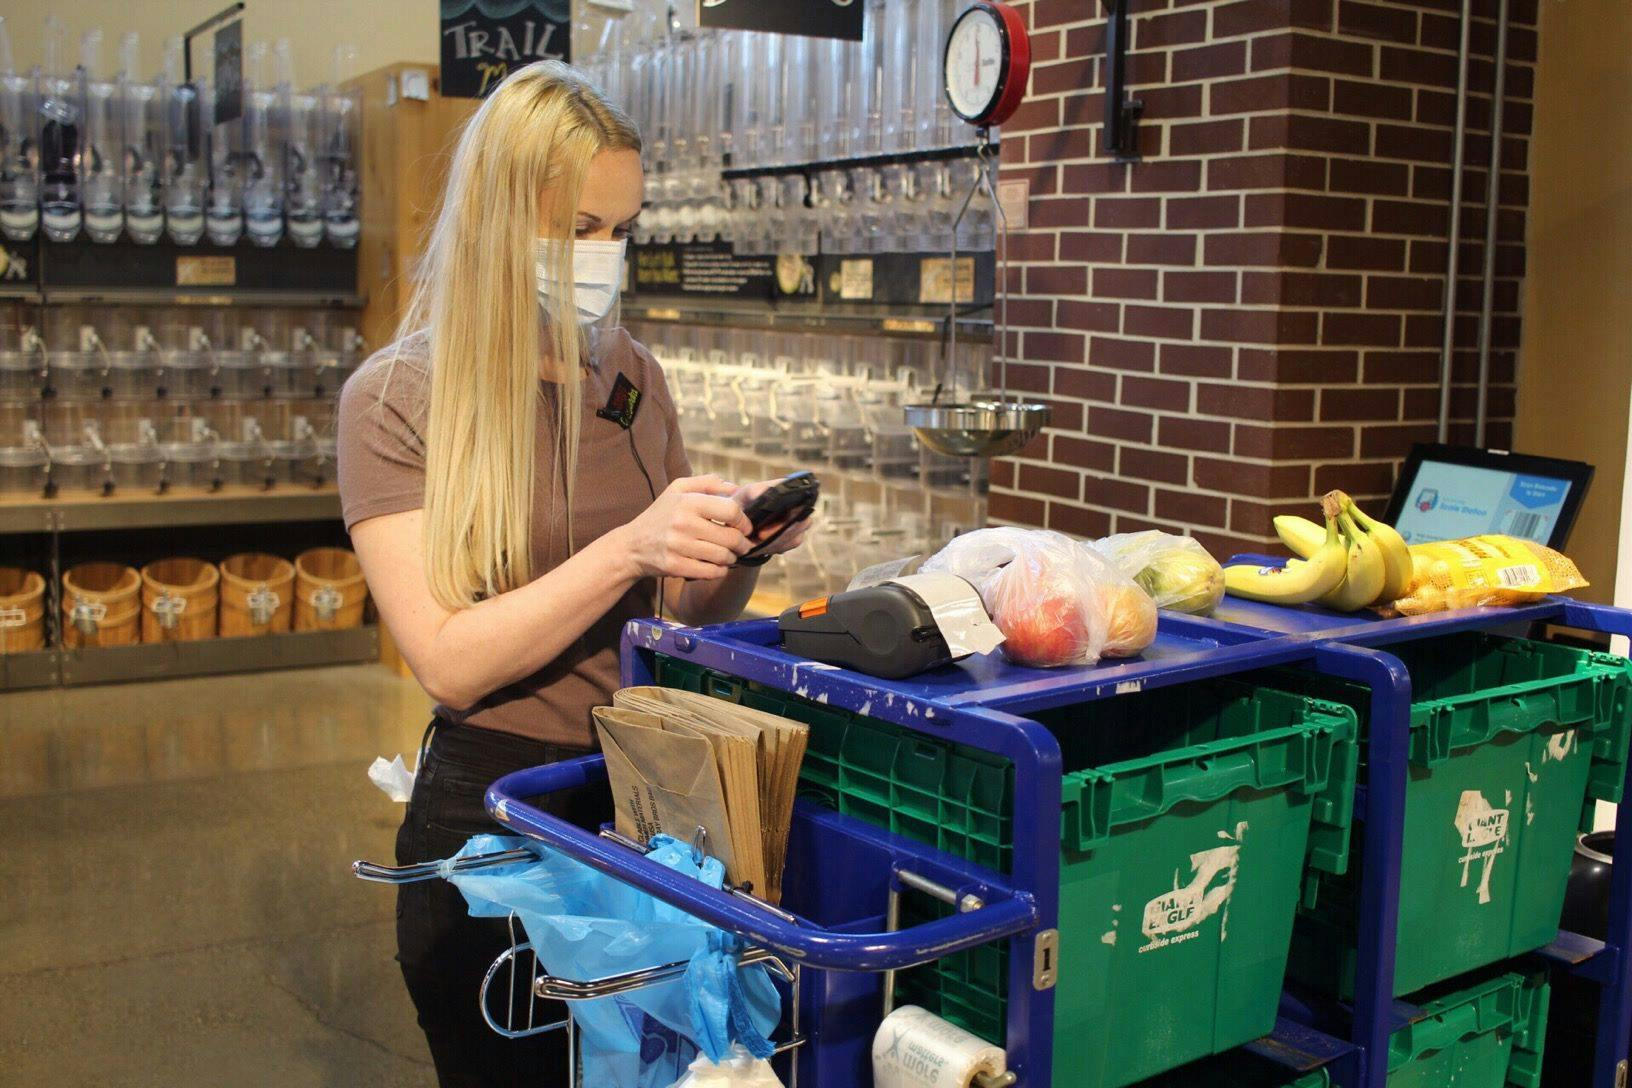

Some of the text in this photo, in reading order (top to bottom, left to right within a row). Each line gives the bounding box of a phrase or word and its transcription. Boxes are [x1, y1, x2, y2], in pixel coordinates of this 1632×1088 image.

[443, 20, 564, 61] TRAIL
[1170, 930, 1199, 945] express
[1043, 947, 1051, 971] 1
